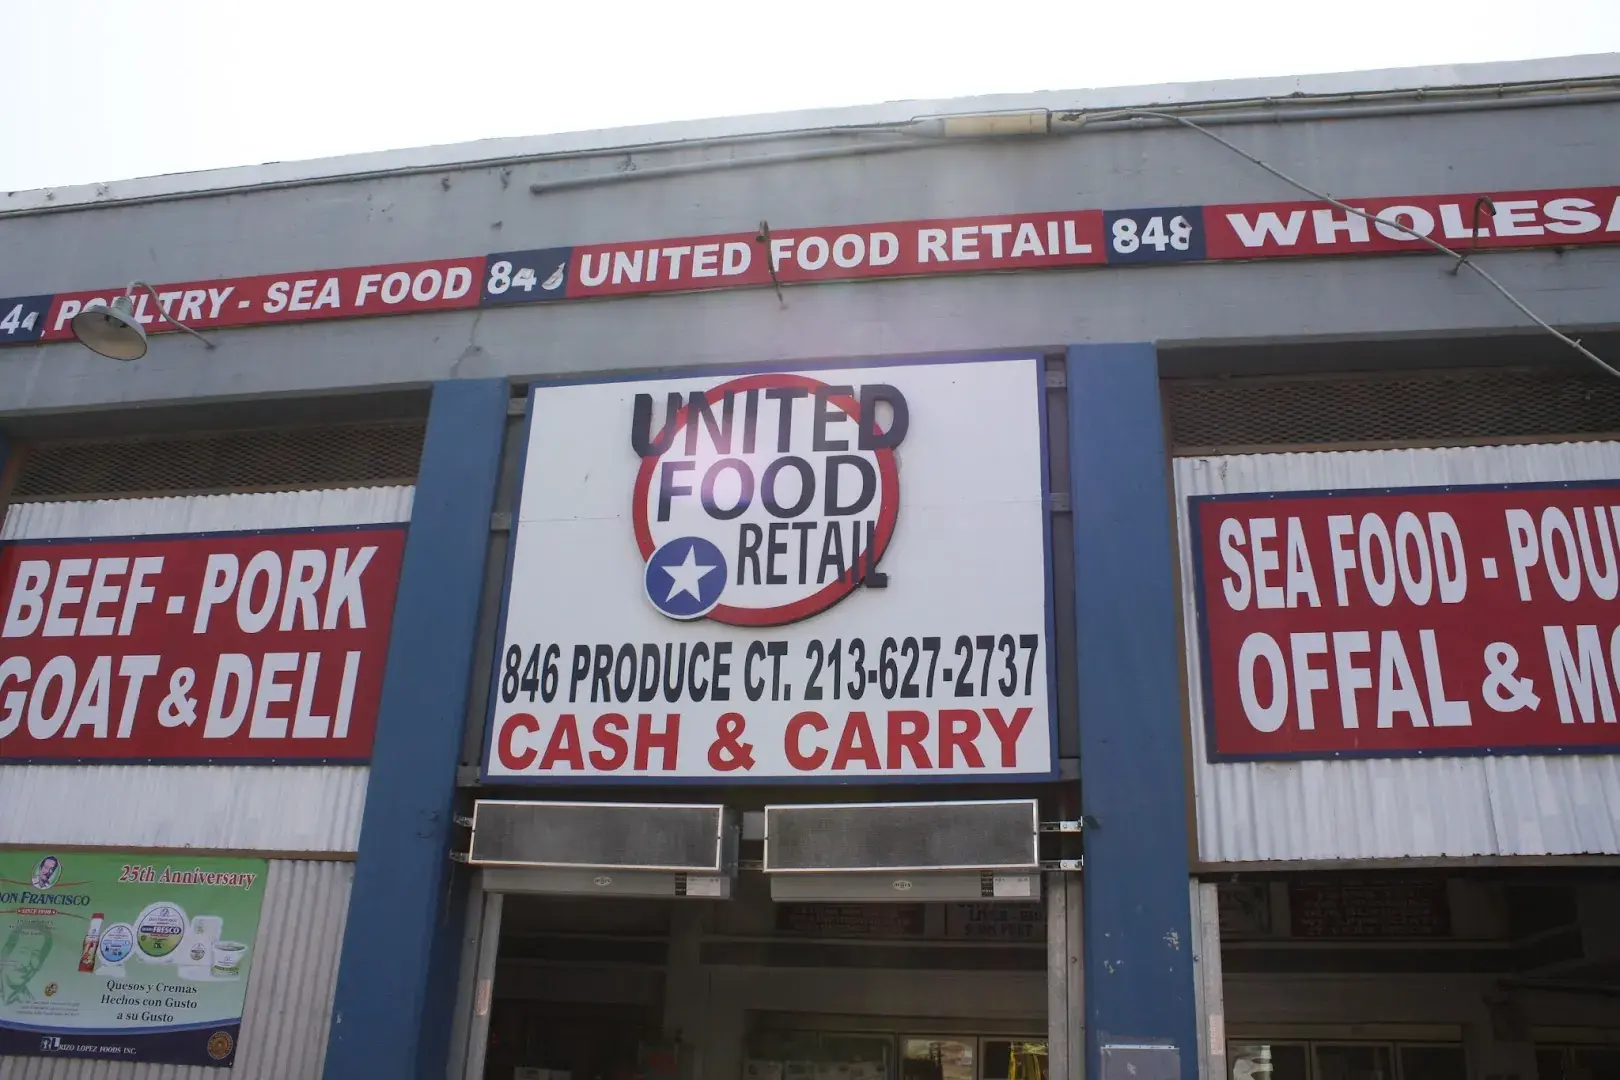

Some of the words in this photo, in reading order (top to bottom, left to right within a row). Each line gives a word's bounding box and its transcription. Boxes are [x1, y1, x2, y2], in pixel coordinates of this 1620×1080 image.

[579, 242, 752, 288] UNITED
[769, 231, 899, 272] FOOD
[917, 220, 1092, 264] RETAIL
[1112, 215, 1192, 254] 848
[53, 286, 235, 331] PLTRY
[263, 276, 342, 314] SEA
[355, 266, 472, 307] FOOD
[631, 384, 909, 458] UNITED
[657, 455, 877, 522] FOOD
[736, 521, 888, 588] RETAIL
[1219, 517, 1322, 611] SEA
[1328, 511, 1467, 607] FOOD
[1505, 505, 1620, 602] POU
[2, 556, 165, 638] BEEF
[193, 546, 379, 634] PORK
[0, 654, 161, 740] GOAT
[157, 666, 198, 728] &
[203, 650, 361, 739] DELI
[502, 643, 559, 703] 846
[569, 640, 732, 703] PRODUCE
[744, 640, 792, 701] CT.
[804, 633, 1039, 701] 213-627-2737
[1238, 629, 1472, 733] OFFAL
[1482, 641, 1541, 713] &
[497, 711, 680, 771] CASH
[707, 711, 756, 771] &
[784, 707, 1033, 771] CARRY
[0, 891, 19, 904] ON
[20, 891, 91, 906] FRANCISCO
[119, 864, 156, 884] 25th
[158, 866, 257, 890] Anniversary
[153, 925, 180, 934] FRESCO
[100, 994, 140, 1006] Hechos
[142, 998, 162, 1007] con
[165, 997, 198, 1009] Gusto
[106, 979, 145, 991] Quesos
[146, 984, 154, 993] y
[156, 982, 198, 994] Cremas
[116, 1012, 123, 1020] a
[125, 1012, 138, 1021] su
[141, 1011, 174, 1023] Gusto
[76, 1045, 98, 1053] LOPEZ
[99, 1046, 121, 1054] FOODS
